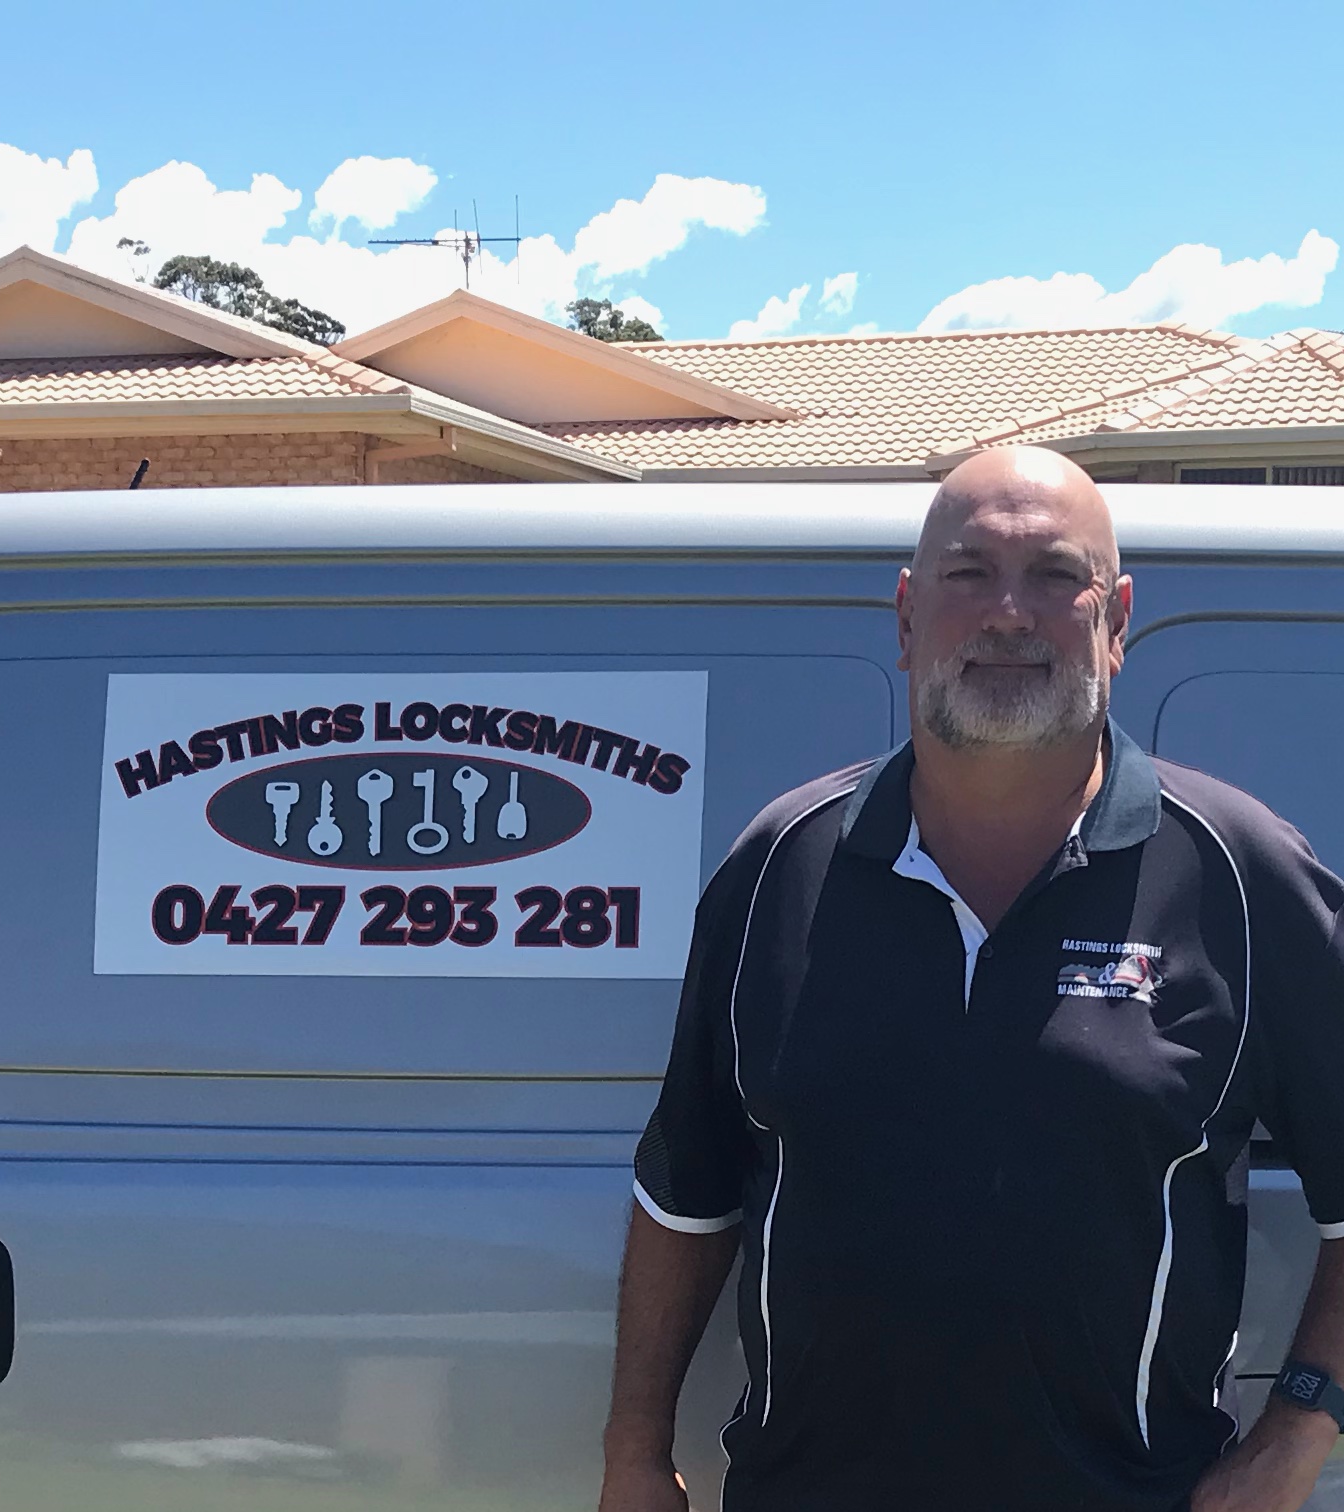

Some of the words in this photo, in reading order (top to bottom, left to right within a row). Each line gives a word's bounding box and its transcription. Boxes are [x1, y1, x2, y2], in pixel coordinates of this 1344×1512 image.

[115, 703, 365, 799] HASTINGS
[374, 701, 692, 795] LOCKSMITHS
[152, 884, 346, 946] 0427
[360, 885, 498, 947] 293
[514, 886, 641, 949] 281
[1062, 938, 1108, 953] HASTINGS
[1098, 962, 1116, 984] &
[1057, 983, 1128, 998] MAINTENANCE
